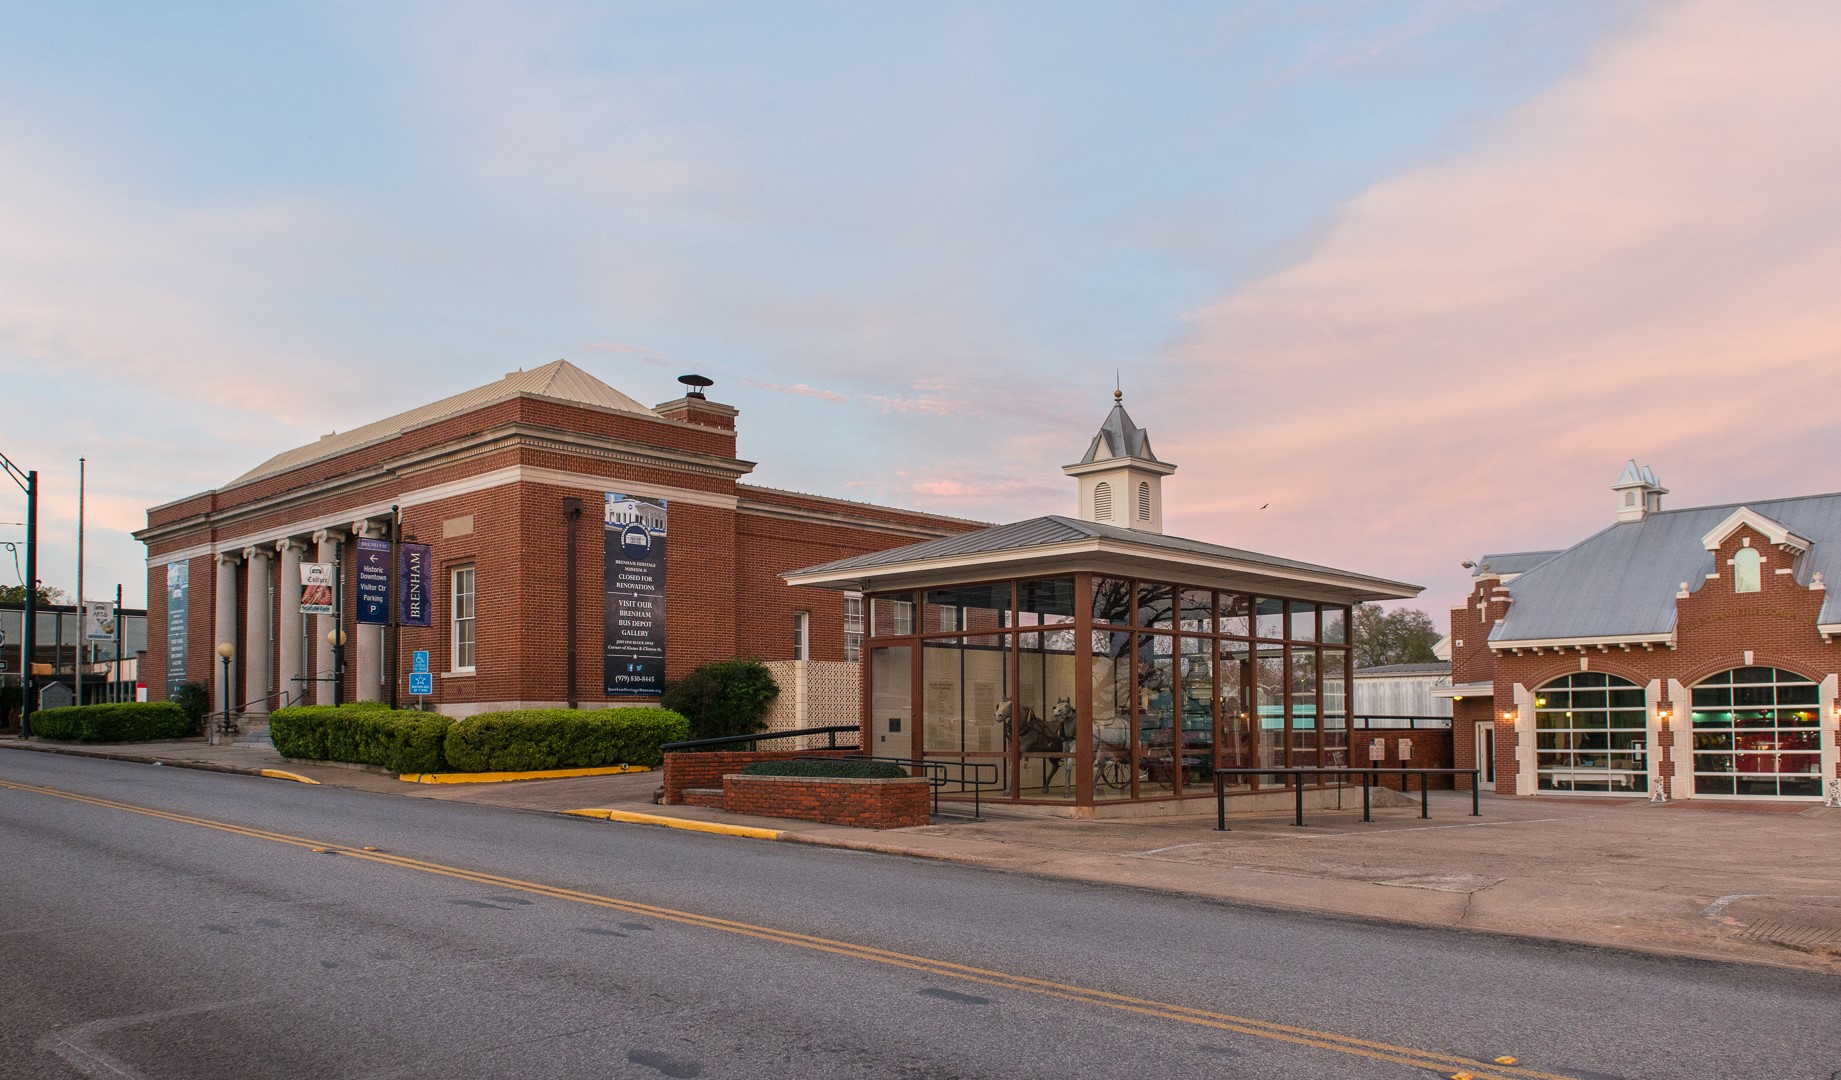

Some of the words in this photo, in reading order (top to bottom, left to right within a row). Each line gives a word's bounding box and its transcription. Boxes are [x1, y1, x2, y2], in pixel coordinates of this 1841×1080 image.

[410, 552, 420, 618] BRENHAM
[616, 582, 655, 590] RENOVATIONS
[364, 594, 383, 603] Parking
